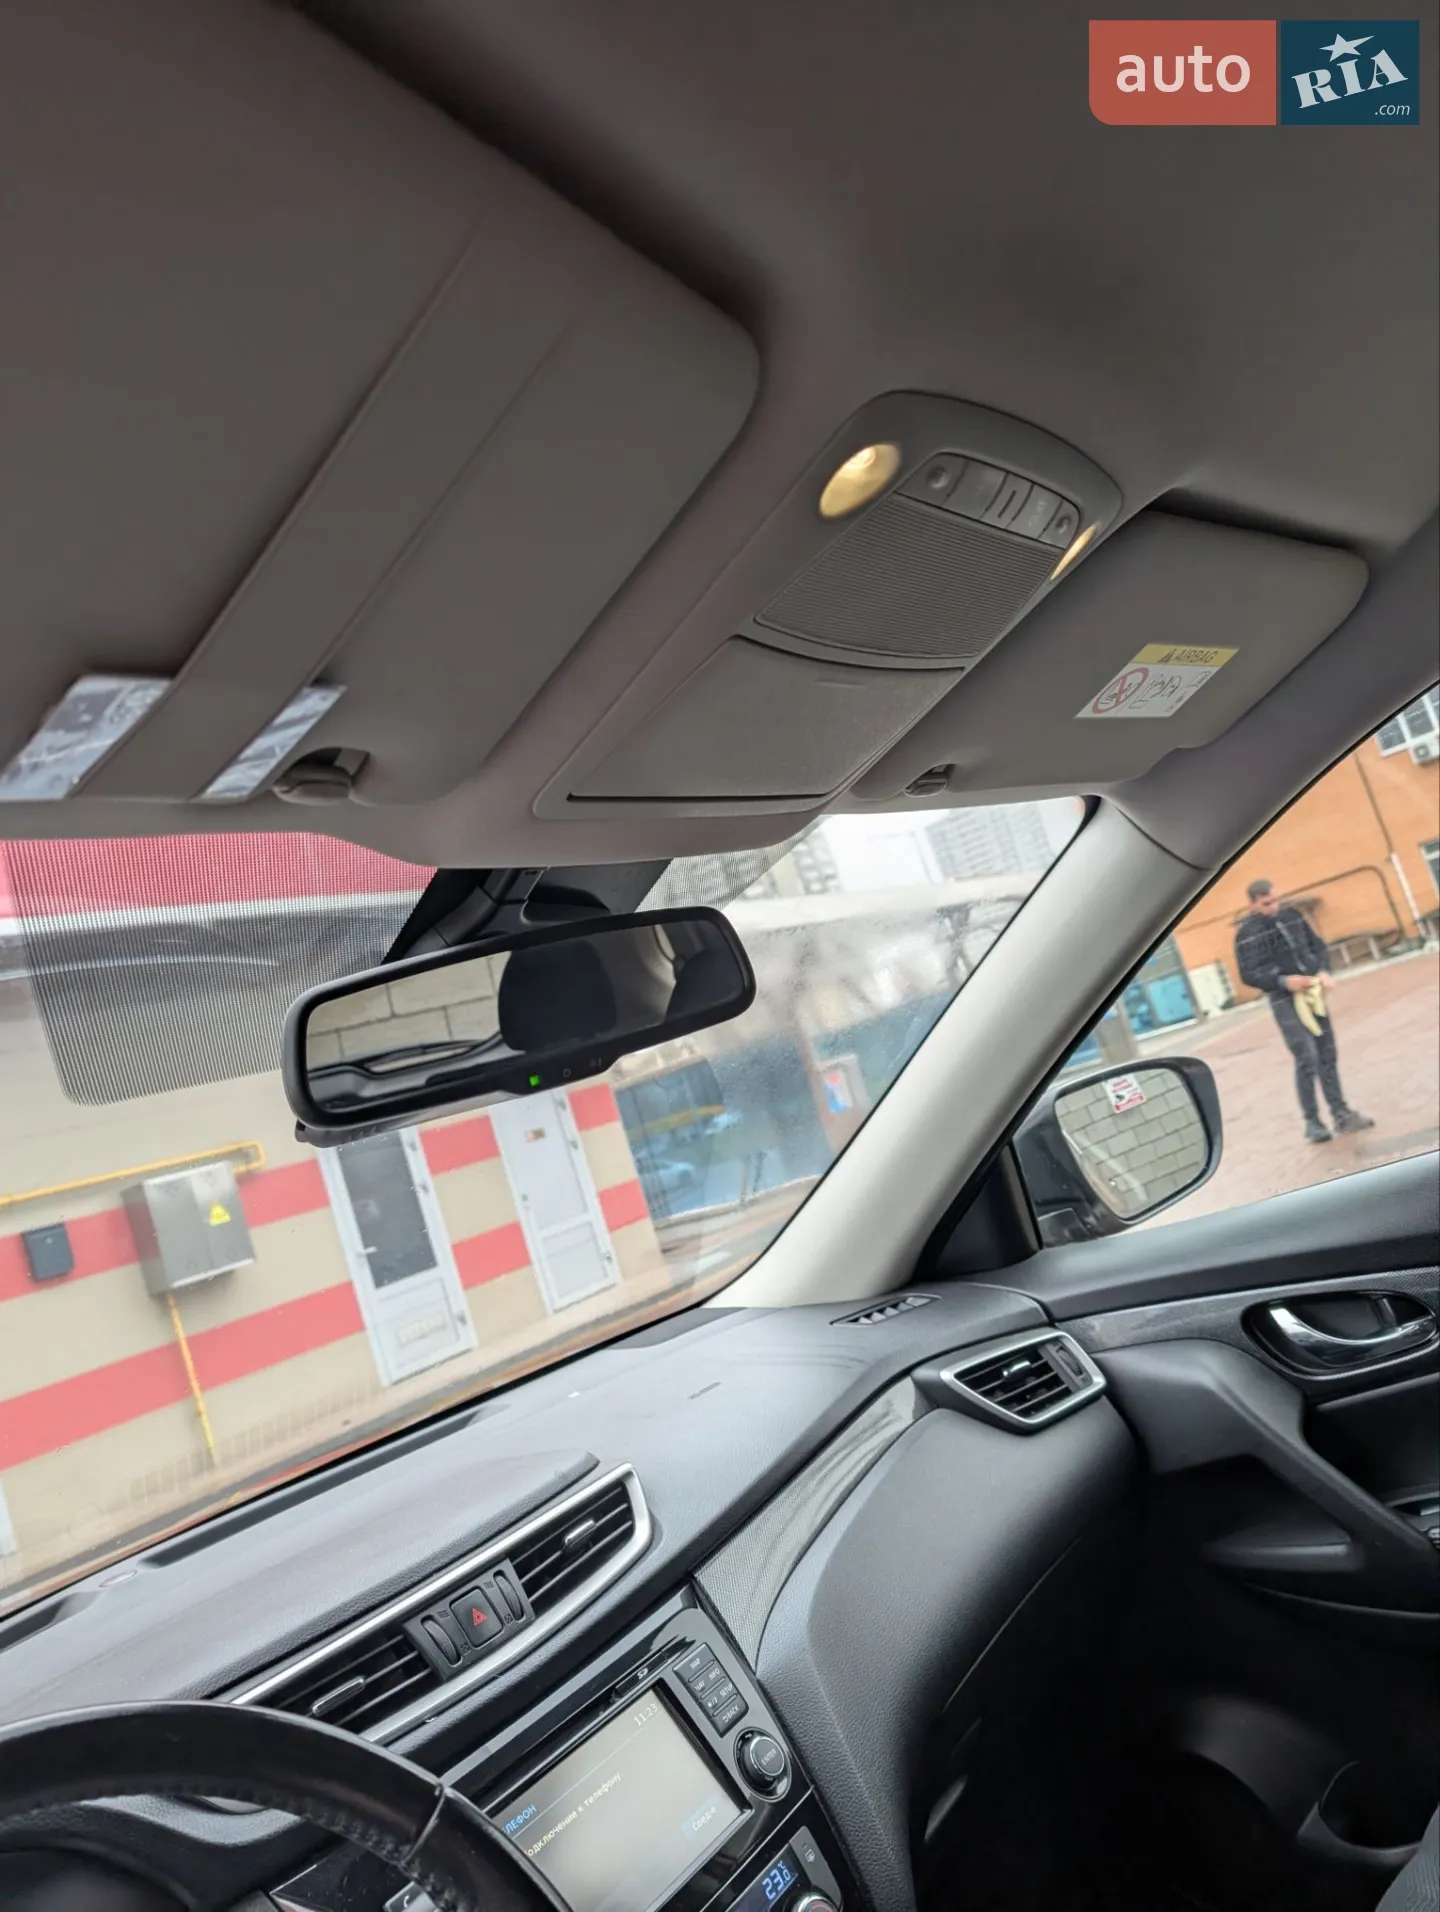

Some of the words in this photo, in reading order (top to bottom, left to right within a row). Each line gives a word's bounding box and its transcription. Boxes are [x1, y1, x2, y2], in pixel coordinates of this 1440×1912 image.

[1173, 648, 1218, 664] AIRBAG
[689, 1658, 701, 1669] MAP
[720, 1683, 734, 1697] SETUP
[633, 1702, 659, 1727] 11:23
[761, 1748, 777, 1766] ENTER
[503, 1804, 537, 1834] ЛЕФОН
